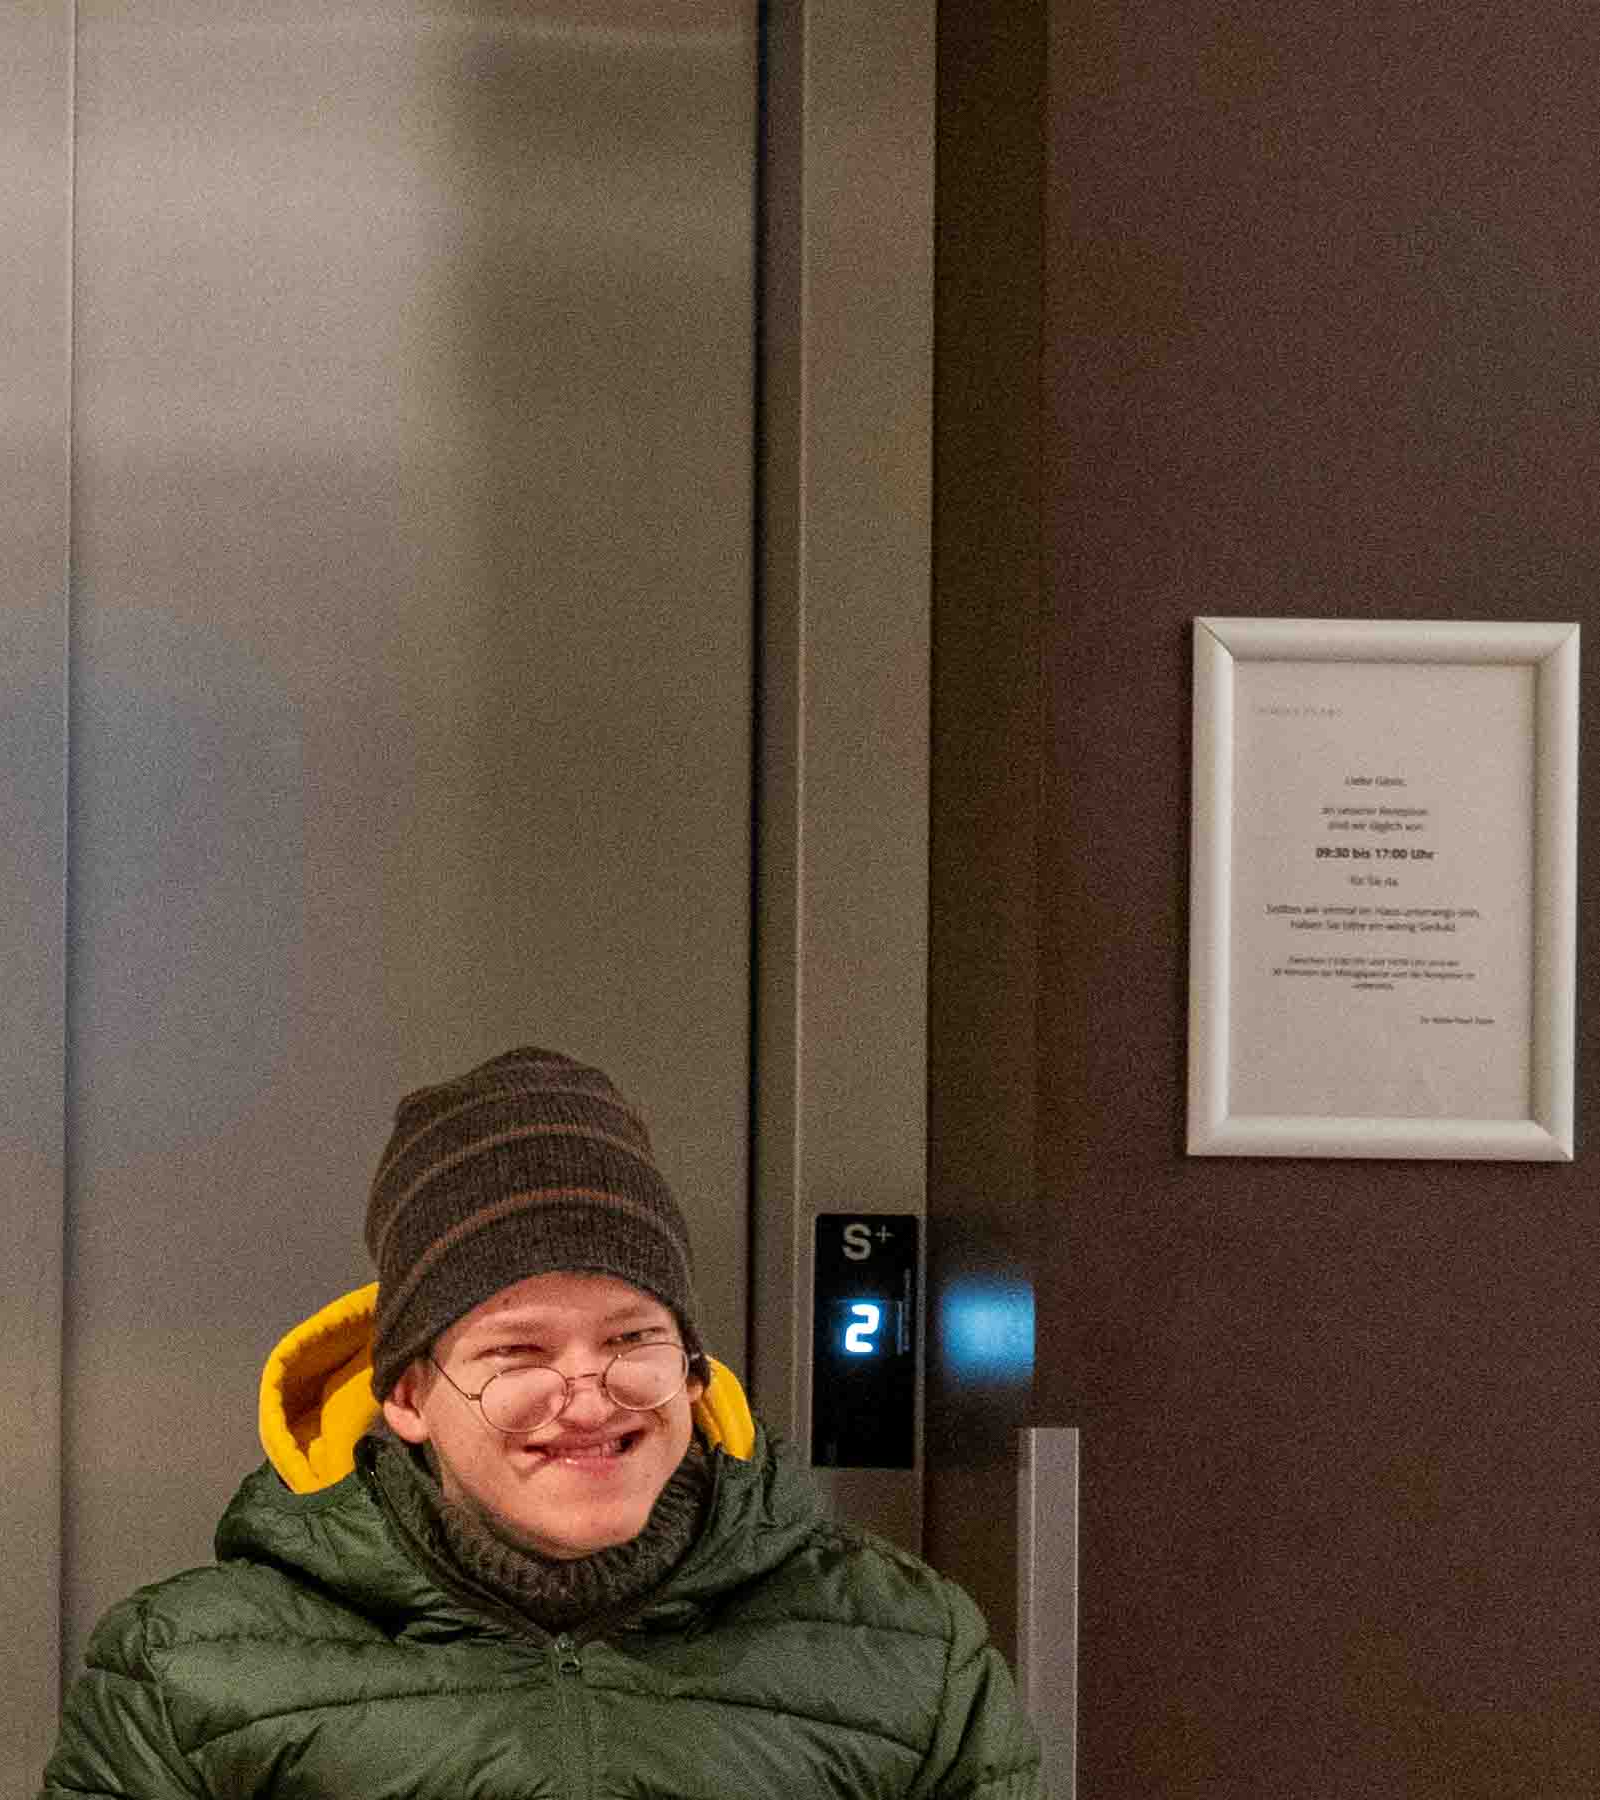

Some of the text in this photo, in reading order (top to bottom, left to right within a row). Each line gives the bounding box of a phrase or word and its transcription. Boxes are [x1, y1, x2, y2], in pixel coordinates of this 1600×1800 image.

[1352, 847, 1371, 859] bis
[1375, 848, 1408, 860] 17:00
[1410, 848, 1435, 860] Uhr
[845, 1303, 881, 1353] 2
